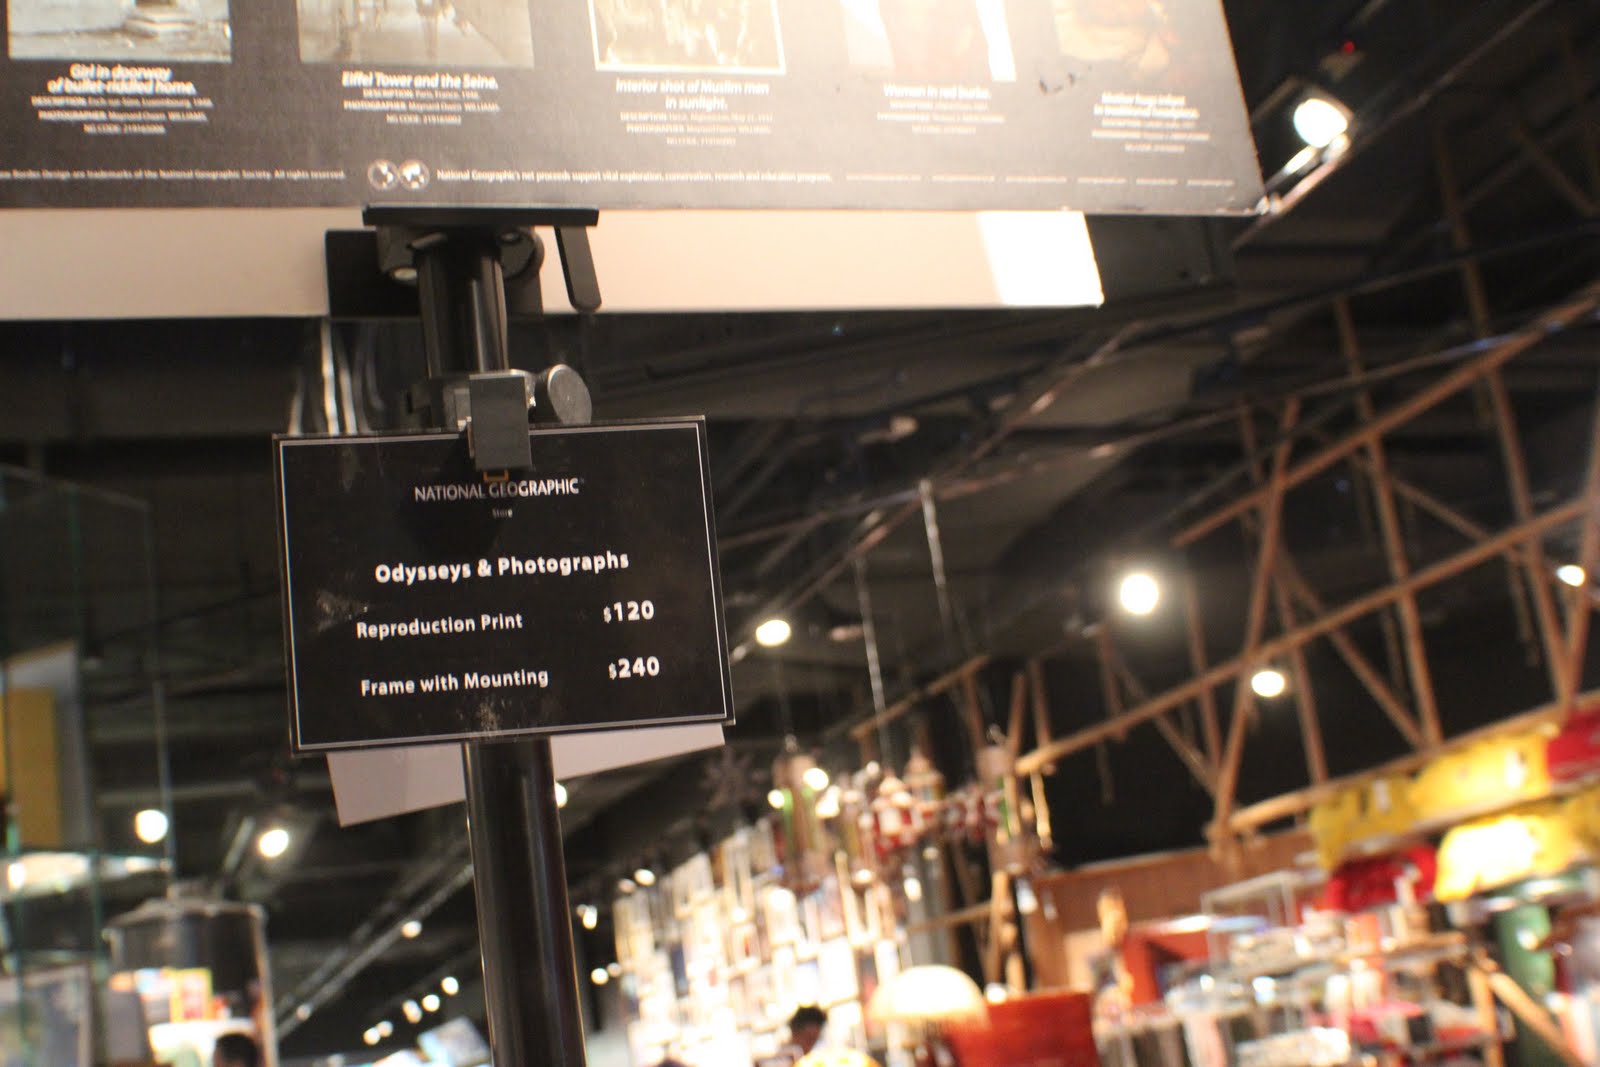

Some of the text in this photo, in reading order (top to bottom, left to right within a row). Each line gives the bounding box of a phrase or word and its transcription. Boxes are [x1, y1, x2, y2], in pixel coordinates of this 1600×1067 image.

[70, 63, 172, 82] Girl in doorway
[342, 70, 373, 87] Eiffel
[374, 71, 412, 88] Tower
[413, 72, 439, 88] and
[440, 72, 461, 89] the
[615, 78, 658, 94] Interior
[659, 79, 685, 94] shot
[686, 79, 700, 94] of
[700, 79, 743, 95] Muslim
[665, 95, 728, 112] in sunlight.
[414, 477, 580, 502] NATIONAL GEOGRAPHIC
[375, 550, 630, 586] Odysseys & Photographs
[603, 600, 655, 624] $120
[356, 612, 523, 641] Reproduction Print
[608, 655, 660, 680] $240
[361, 668, 549, 697] Frame with Mounting
